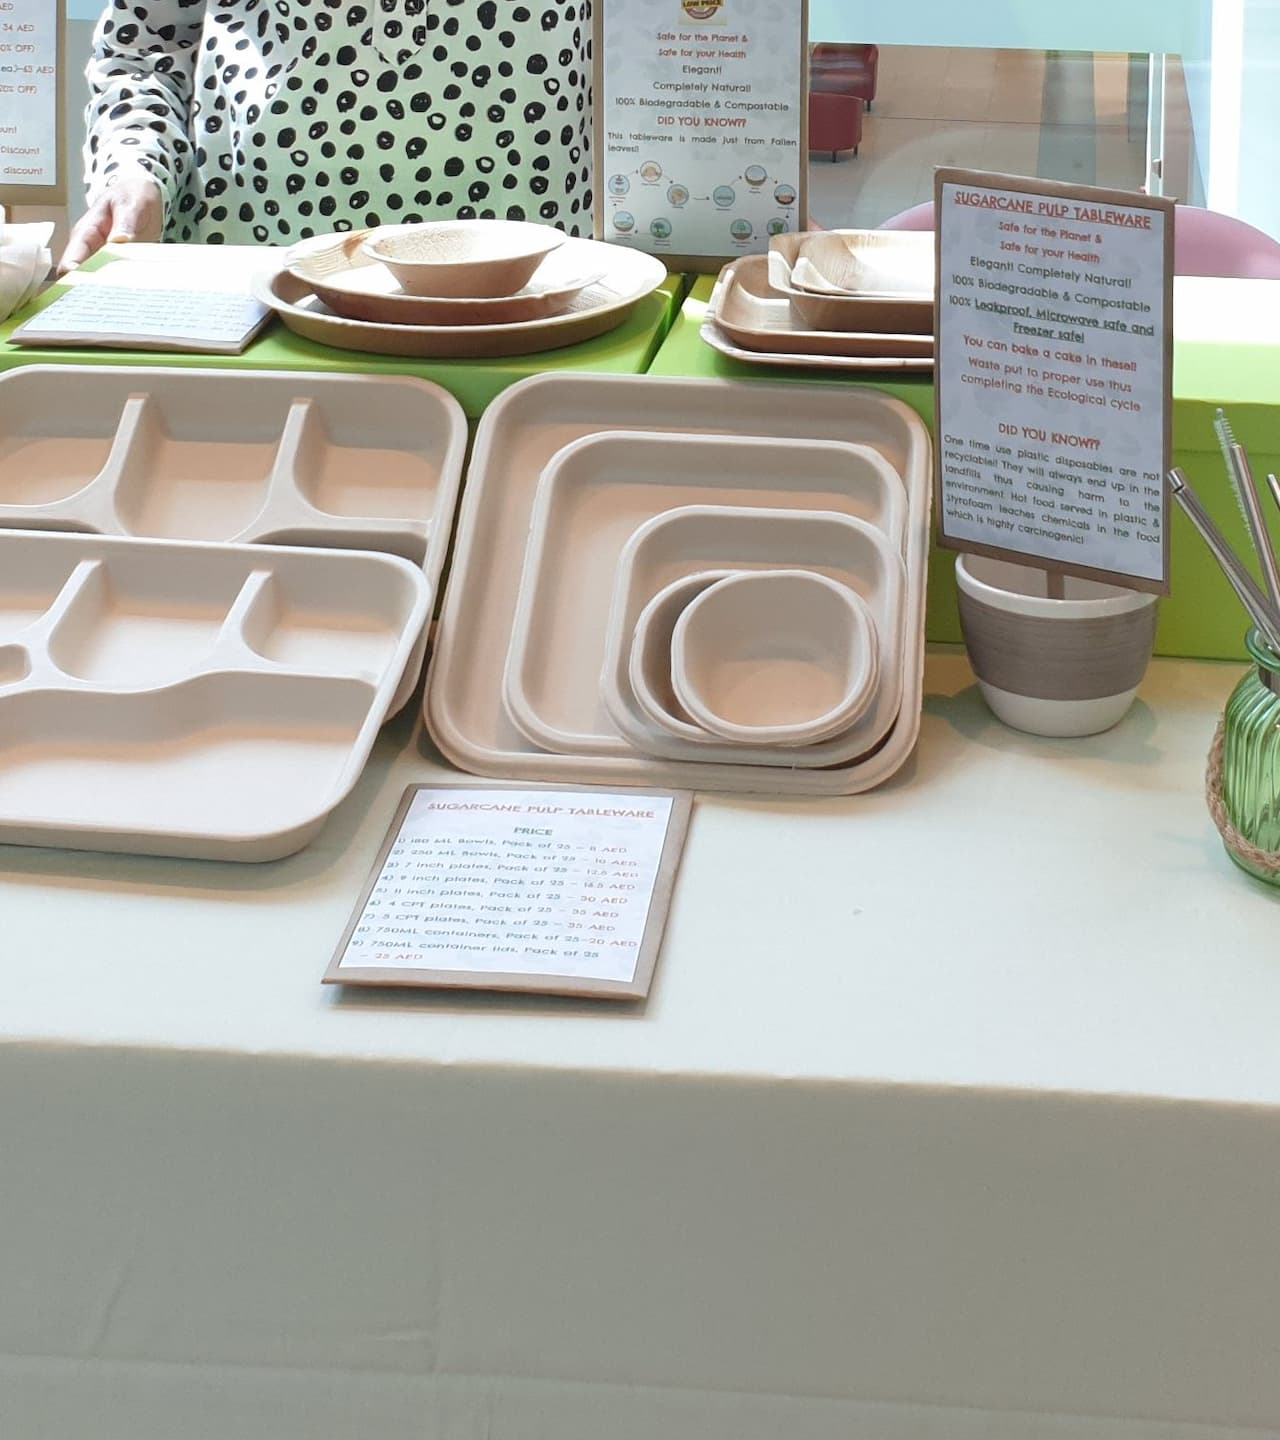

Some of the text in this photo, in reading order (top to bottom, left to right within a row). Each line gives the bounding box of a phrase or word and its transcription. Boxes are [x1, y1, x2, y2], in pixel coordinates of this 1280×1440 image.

[653, 82, 708, 93] Completely
[616, 98, 789, 112] 100% Biodegradable & Compostable
[657, 116, 747, 128] DID YOU KNOW??
[955, 192, 1151, 229] SUGARCANE PULP TABLEWARE
[999, 222, 1102, 244] Safe for the Planet &
[1001, 241, 1100, 263] Safe for your Health
[1018, 263, 1080, 283] Completely
[952, 274, 1151, 312] 100% Biodegradable & Compostable
[963, 335, 983, 348] You
[987, 341, 1007, 352] can
[1012, 343, 1039, 357] bake
[1043, 350, 1050, 358] a
[1055, 351, 1082, 363] cake
[1087, 355, 1096, 366] in
[998, 423, 1100, 450] DID YOU KNOW??
[427, 802, 655, 819] SUGARCANE PULP TABLEWARE
[514, 826, 553, 836] PRICE
